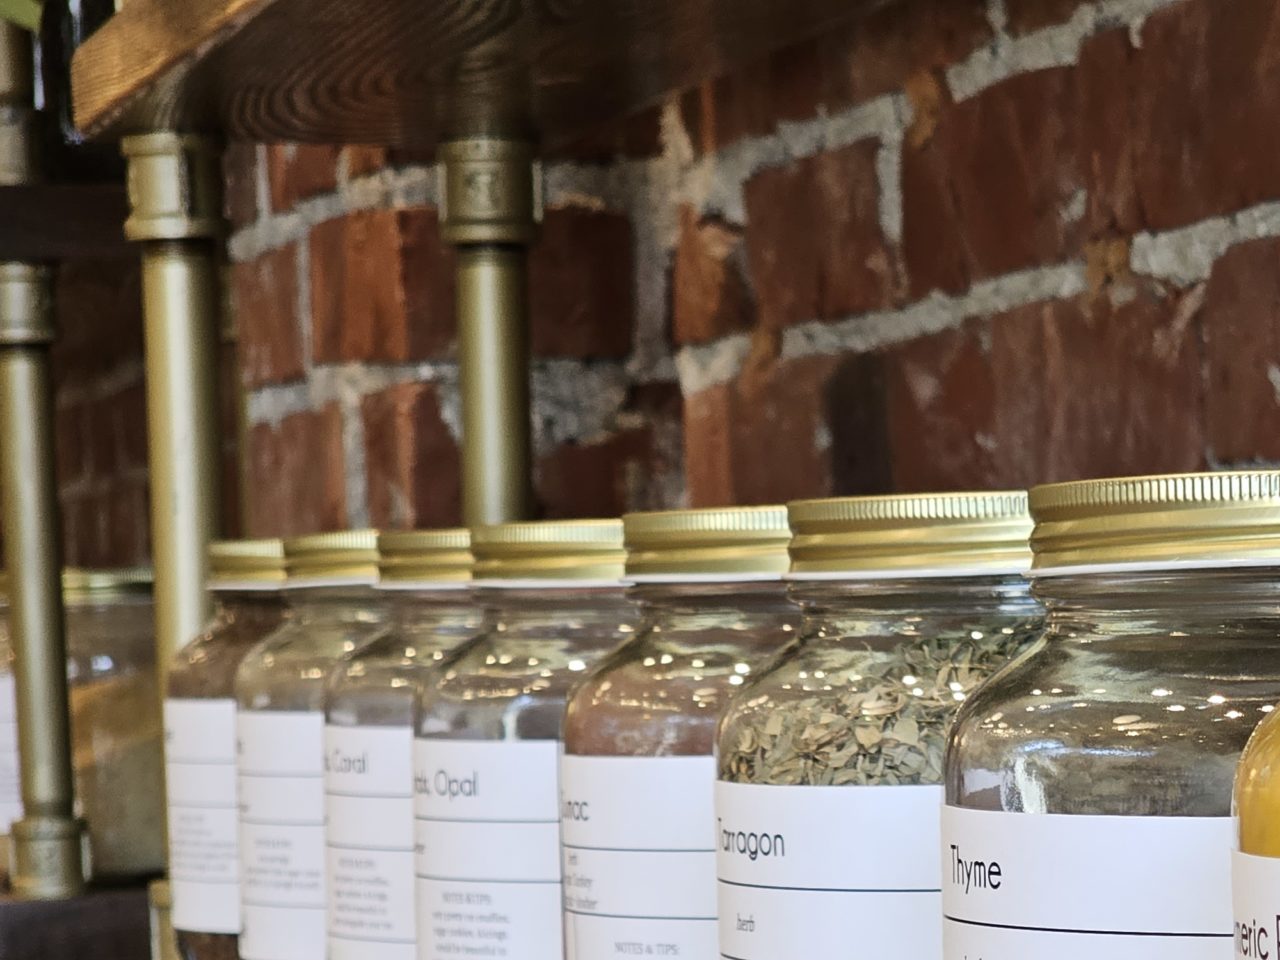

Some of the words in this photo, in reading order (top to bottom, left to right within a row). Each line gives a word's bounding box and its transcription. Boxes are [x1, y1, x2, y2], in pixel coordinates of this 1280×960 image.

[434, 769, 478, 801] Opal
[951, 844, 1002, 894] Thyme
[614, 942, 643, 955] NOTES
[645, 944, 653, 955] &
